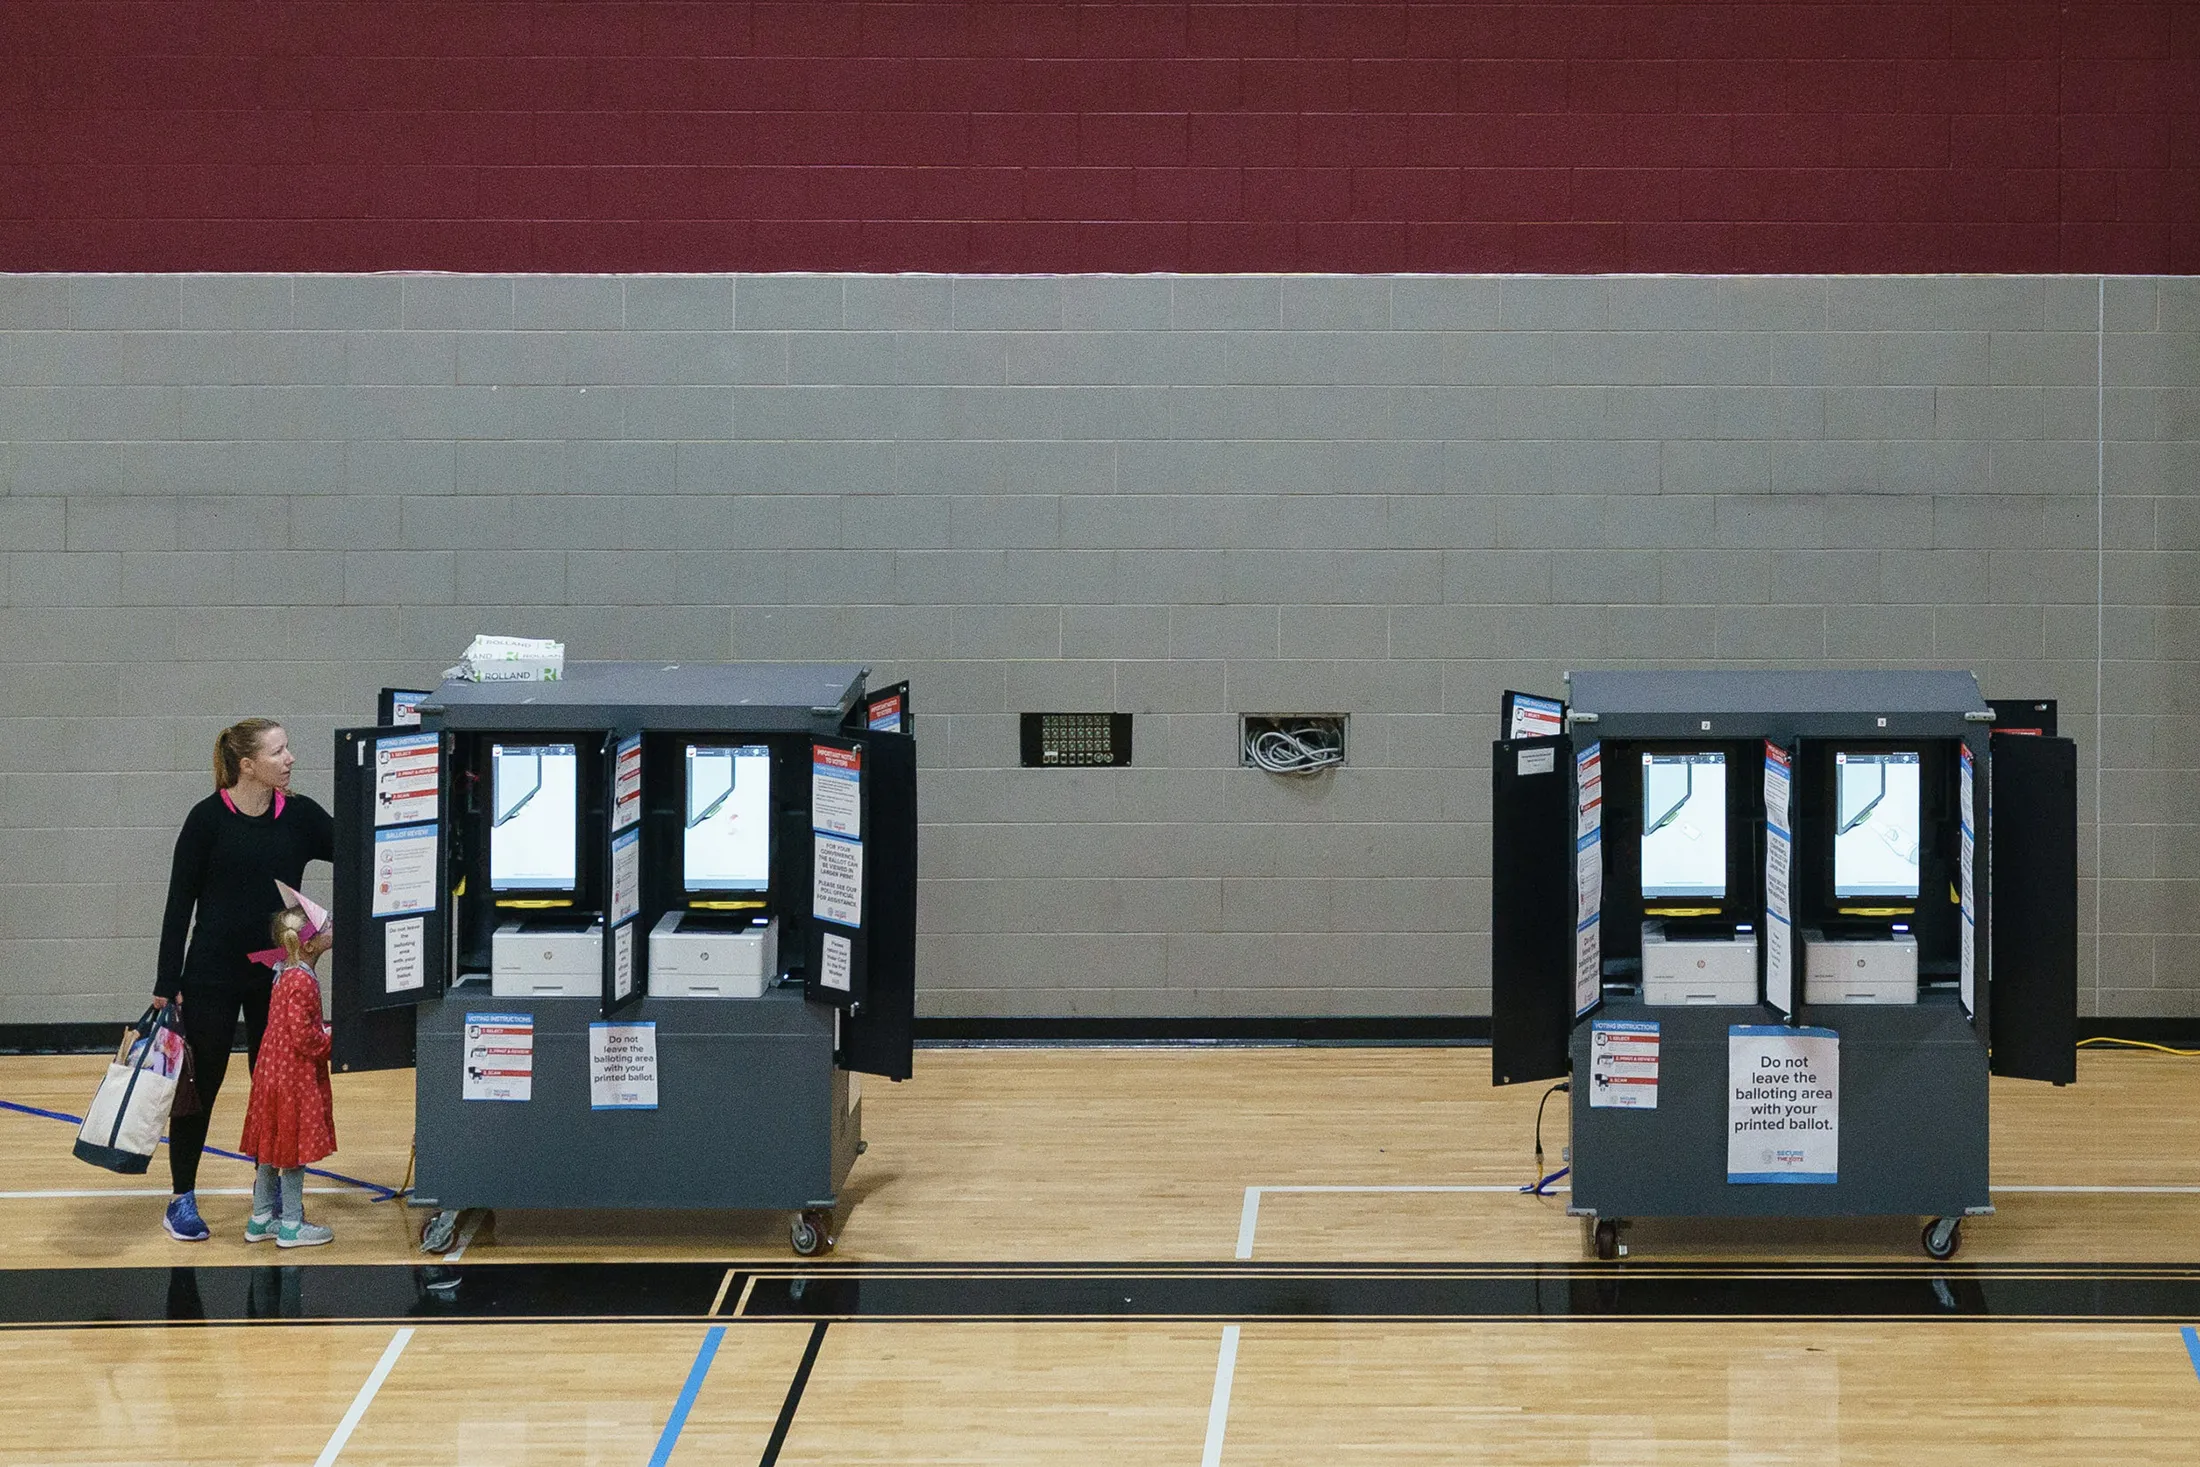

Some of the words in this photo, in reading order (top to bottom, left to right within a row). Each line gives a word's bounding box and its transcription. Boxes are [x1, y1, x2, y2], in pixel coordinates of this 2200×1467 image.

[484, 671, 531, 681] ROLLAND
[1595, 1022, 1616, 1030] VOTING
[1616, 1023, 1658, 1031] INSTRUCTIONS
[609, 1035, 622, 1043] Do
[603, 1045, 628, 1053] leave
[630, 1044, 644, 1053] the
[594, 1054, 633, 1063] balloting
[1761, 1055, 1781, 1068] Do
[1785, 1056, 1809, 1068] not
[603, 1064, 624, 1072] with
[625, 1065, 645, 1073] your
[594, 1073, 626, 1083] printed
[1752, 1072, 1790, 1084] leave
[1793, 1071, 1817, 1083] the
[1735, 1087, 1797, 1101] balloting
[1801, 1090, 1833, 1100] area
[1750, 1103, 1781, 1115] with
[1784, 1104, 1818, 1117] your
[1734, 1118, 1785, 1133] printed
[1789, 1118, 1833, 1130] ballot.
